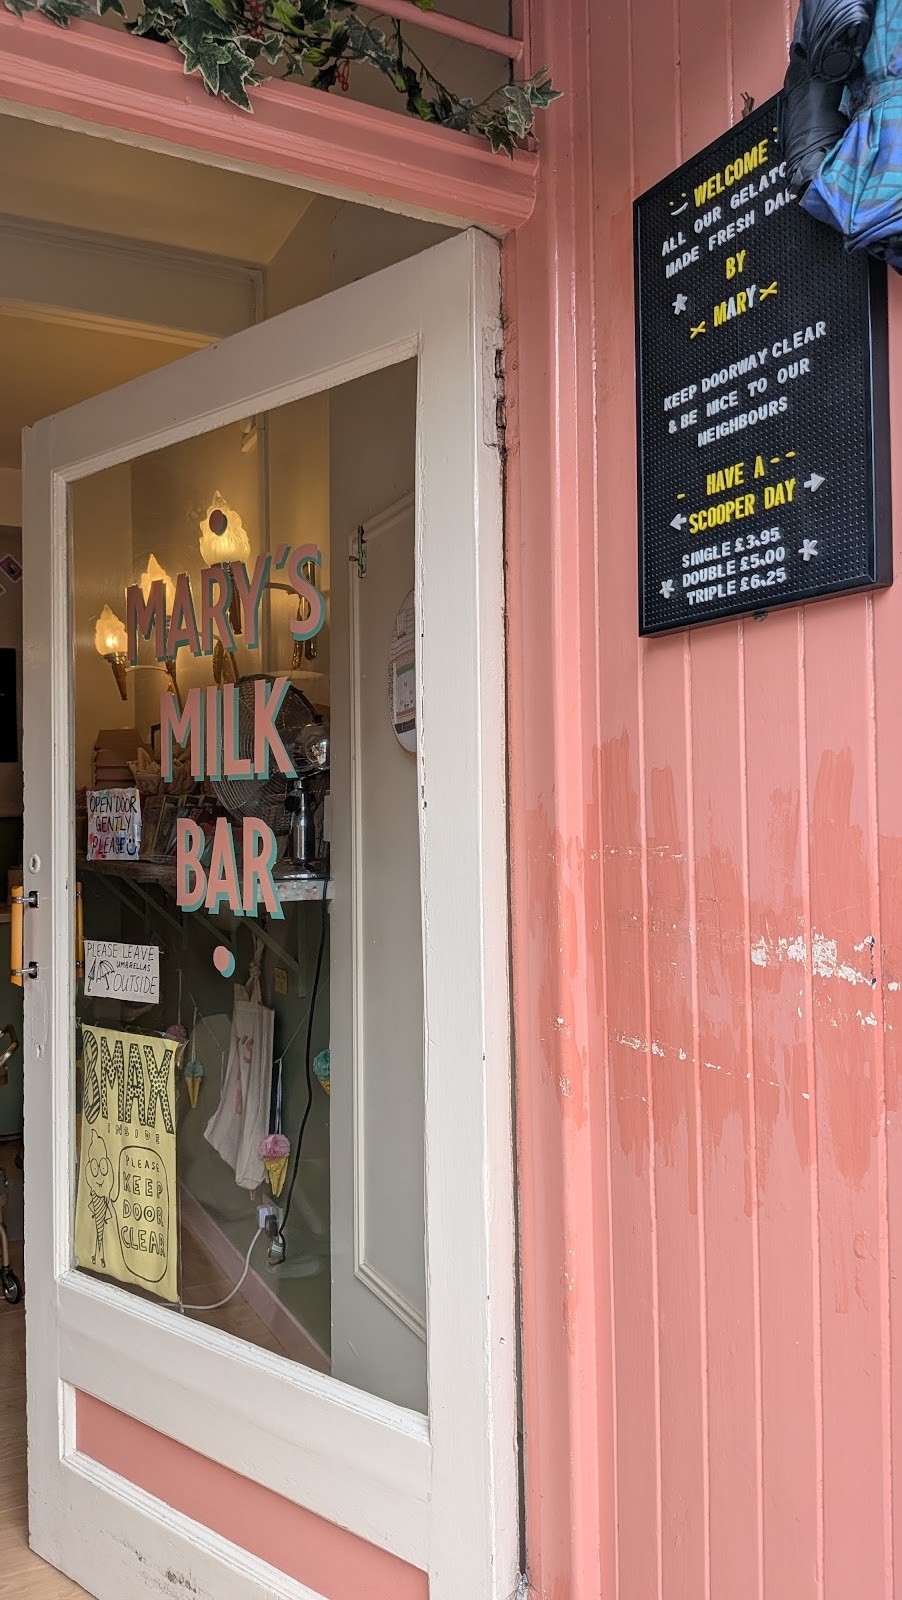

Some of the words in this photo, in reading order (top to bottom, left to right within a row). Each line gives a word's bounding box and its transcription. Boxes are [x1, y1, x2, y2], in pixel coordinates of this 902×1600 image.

[694, 139, 769, 207] WELCOME
[662, 231, 686, 256] ALL
[694, 206, 722, 233] OUR
[666, 246, 699, 279] MADE
[709, 210, 755, 251] FRESH
[726, 250, 746, 280] BY
[714, 284, 756, 327] MARY
[664, 384, 697, 411] KEEP
[702, 348, 768, 393] DOORWAY
[772, 321, 826, 358] CLEAR
[668, 420, 677, 434] &
[680, 409, 698, 430] BE
[706, 390, 739, 417] NICE
[748, 377, 768, 397] TO
[777, 357, 810, 384] OUR
[697, 396, 788, 447] NEIGHBOURS
[706, 462, 744, 495] HAVE
[754, 455, 765, 479] A
[689, 493, 755, 535] SCOOPER
[764, 478, 796, 510] DAY
[682, 541, 731, 568] SINGLE
[734, 527, 781, 553] £3.95
[682, 560, 736, 588] DOUBLE
[740, 546, 786, 572] £5.00
[125, 543, 326, 666] MARY'S
[686, 580, 736, 605] TRIPLE
[740, 567, 786, 592] £6.25
[160, 676, 299, 783] MILK
[90, 796, 112, 813] OPEN
[116, 796, 137, 813] DOOR
[96, 814, 131, 833] GENTLY
[91, 835, 126, 855] PLEASE
[176, 816, 285, 920] BAR
[87, 942, 118, 958] PLEASE
[123, 944, 155, 961] LEAVE
[116, 960, 151, 972] UMBRELLAS
[113, 973, 158, 995] OUTSIDE
[107, 1122, 161, 1144] INSIDE
[125, 1154, 160, 1173] PLEASE
[122, 1171, 163, 1199] KEEP
[122, 1199, 164, 1228] DOOR
[120, 1225, 166, 1258] CLEAR
